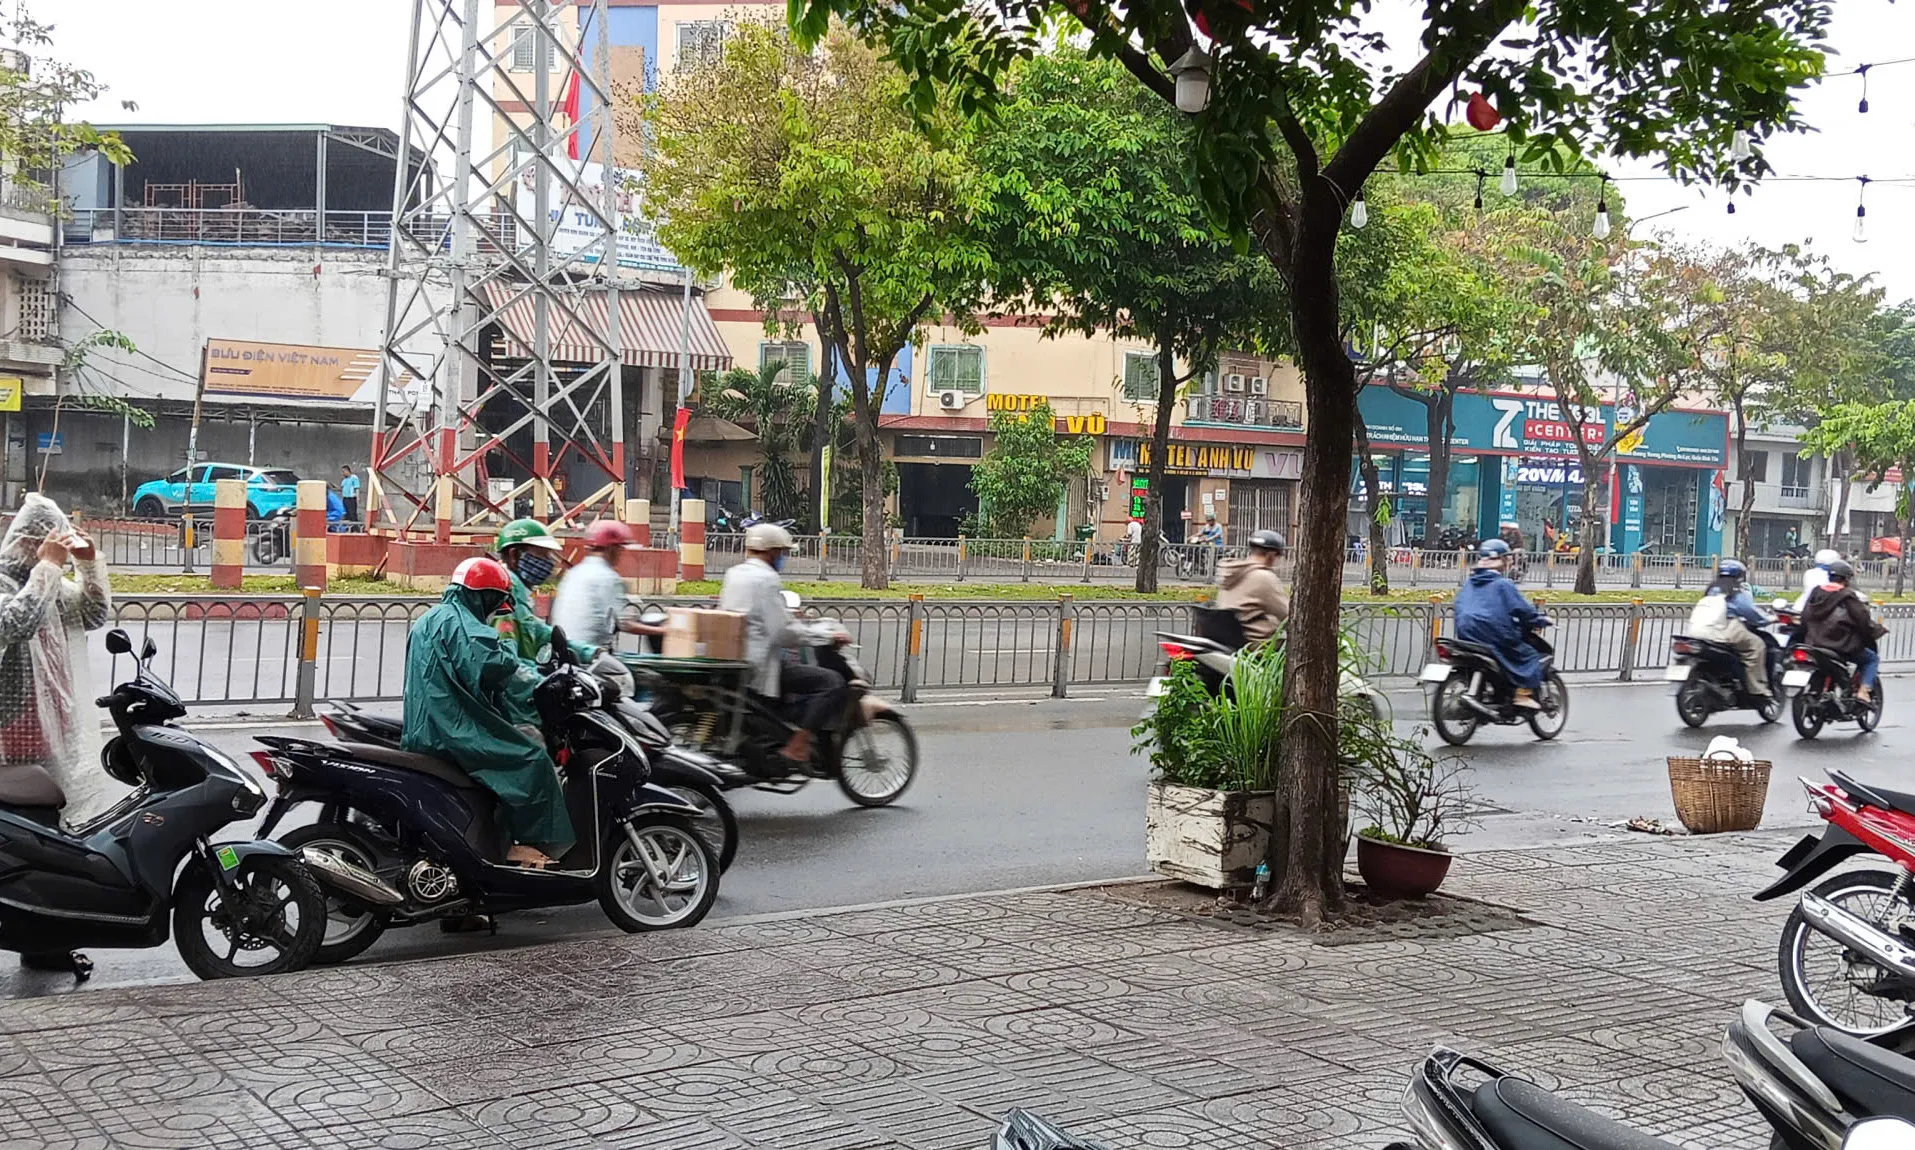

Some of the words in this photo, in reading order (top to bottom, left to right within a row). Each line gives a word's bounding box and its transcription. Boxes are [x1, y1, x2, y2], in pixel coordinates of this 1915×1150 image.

[278, 352, 308, 366] VIỆT
[310, 358, 340, 368] NAM
[1526, 401, 1560, 421] THE
[1066, 411, 1105, 434] VŨ
[1139, 443, 1191, 468] MTEL
[1197, 446, 1230, 470] ANH
